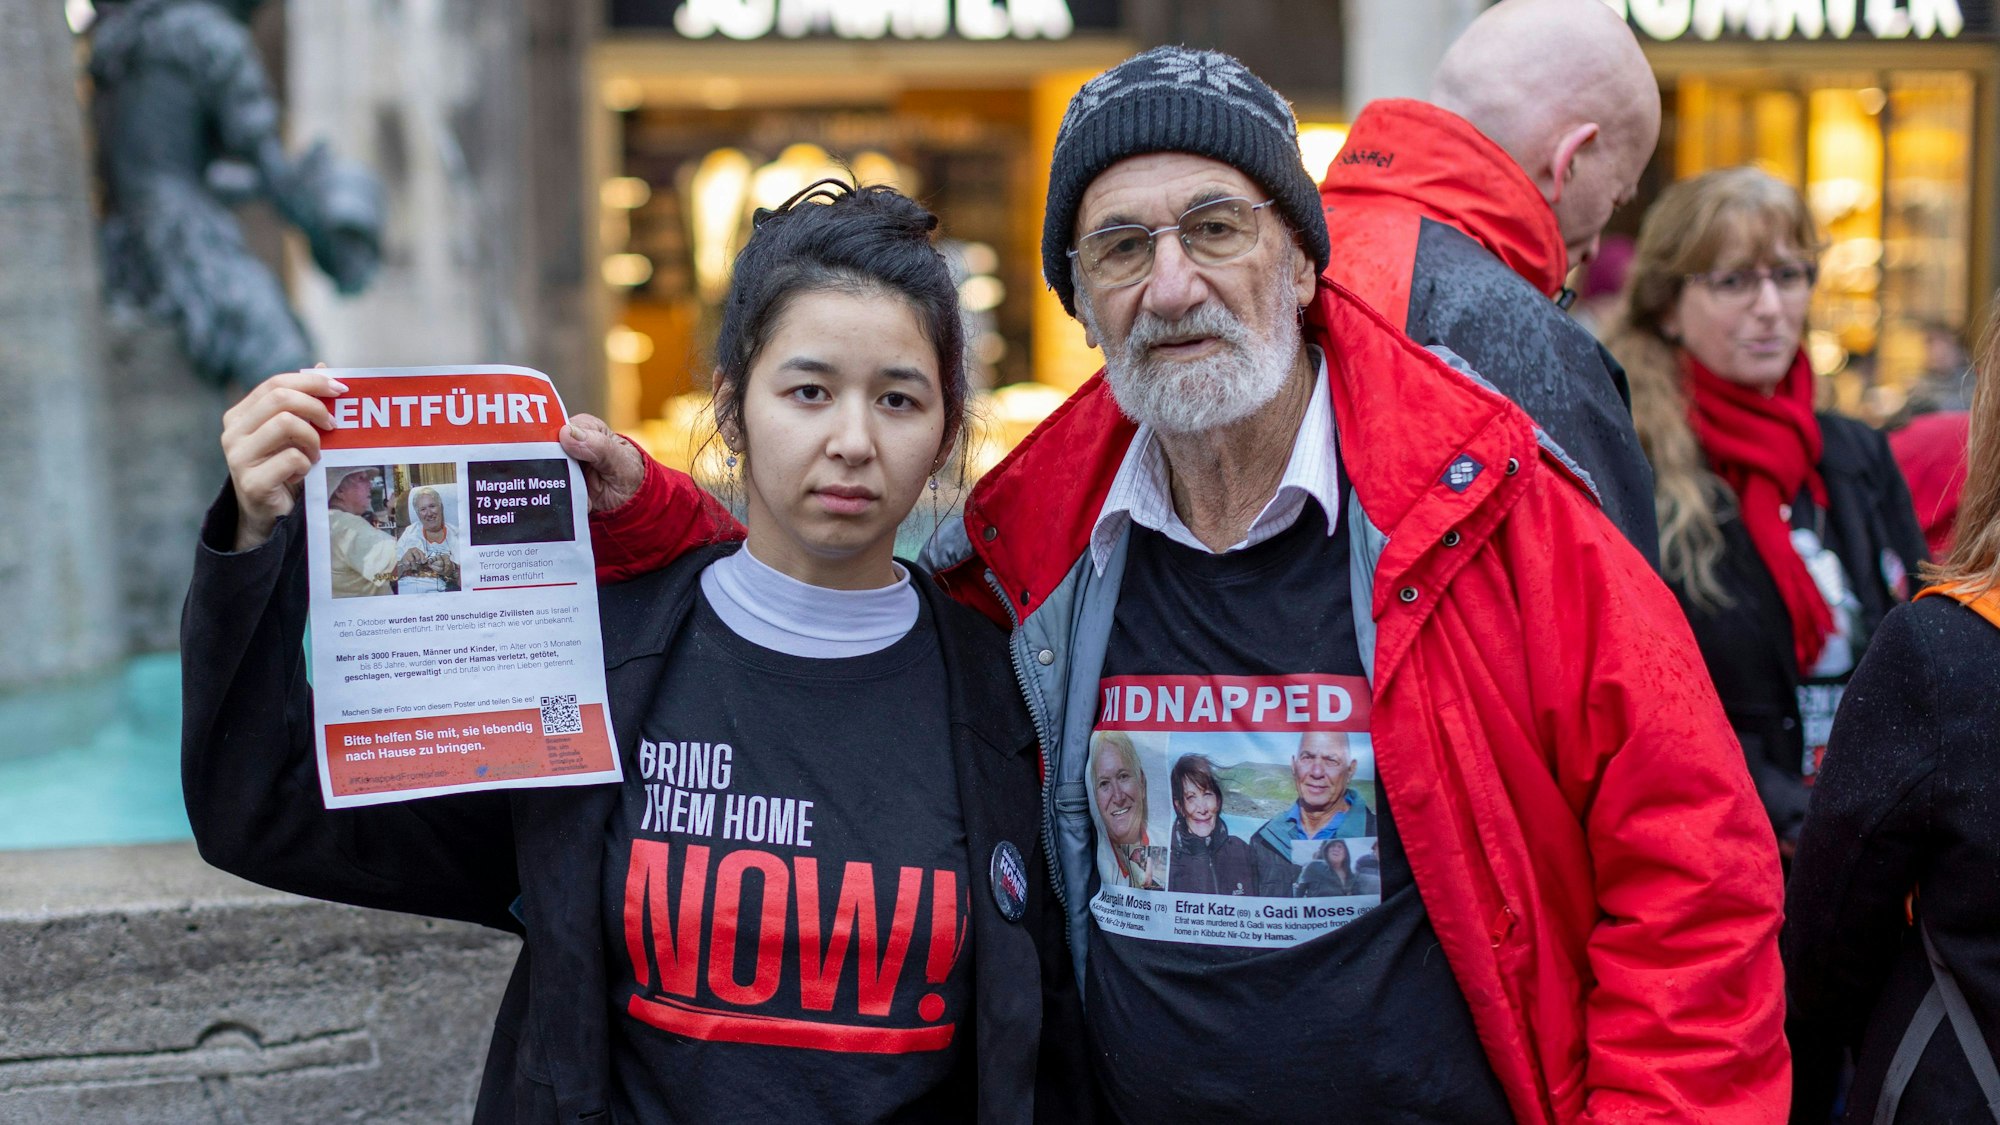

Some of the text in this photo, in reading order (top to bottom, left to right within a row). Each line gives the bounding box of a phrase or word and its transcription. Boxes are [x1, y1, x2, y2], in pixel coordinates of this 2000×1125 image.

[334, 388, 548, 429] ENTFÜHRT
[476, 477, 566, 494] Margalit Moses
[476, 493, 551, 511] 78 years old
[477, 512, 515, 525] Israeli
[479, 547, 538, 558] wurde von der
[479, 558, 554, 571] Terrororganisation
[480, 570, 545, 583] Hamas entführt
[333, 620, 346, 628] Am
[348, 619, 356, 627] 7.
[357, 618, 387, 627] Oktober
[388, 615, 417, 625] wurden
[419, 614, 434, 623] fast
[435, 613, 449, 621] 200
[451, 611, 498, 621] unschuldige
[500, 608, 534, 618] Zivilisten
[551, 606, 571, 614] Israel
[572, 605, 579, 613] in
[339, 630, 354, 638] den
[355, 627, 402, 637] Gazastreifen
[403, 625, 433, 634] entführt.
[447, 622, 476, 631] Verbleib
[477, 621, 486, 629] ist
[488, 620, 506, 628] nach
[507, 618, 520, 627] wie
[521, 618, 533, 626] vor
[534, 616, 575, 626] unbekannt.
[336, 654, 356, 662] Mehr
[357, 653, 369, 661] als
[371, 651, 390, 660] 3000
[391, 650, 421, 659] Frauen,
[423, 647, 451, 656] Männer
[453, 646, 468, 654] und
[470, 644, 498, 653] Kinder,
[550, 638, 582, 647] Monaten
[360, 663, 371, 671] bis
[373, 662, 382, 670] 85
[384, 660, 408, 669] Jahre,
[409, 658, 437, 667] wurden
[497, 652, 528, 661] verletzt,
[530, 650, 559, 659] getötet,
[344, 671, 392, 683] geschlagen,
[394, 668, 442, 679] vergewaltigt
[459, 665, 480, 674] brutal
[517, 660, 542, 669] Lieben
[543, 659, 575, 668] getrennt.
[342, 708, 370, 717] Machen
[396, 705, 412, 713] Foto
[427, 702, 453, 710] diesem
[454, 700, 476, 709] Poster
[492, 697, 510, 705] teilen
[511, 696, 523, 704] Sie
[524, 695, 535, 703] es!
[343, 721, 533, 747] Bitte helfen Sie mit, sie lebendig
[345, 742, 486, 762] nach Hause zu bringen.
[639, 738, 733, 790] BRING
[640, 784, 814, 847] THEM HOME
[1125, 895, 1152, 911] Moses
[1154, 903, 1168, 914] (78)
[1175, 900, 1204, 914] Efrat
[1208, 902, 1236, 917] Katz
[1236, 909, 1251, 919] (69)
[1254, 910, 1261, 918] &
[1263, 905, 1298, 919] Gadi
[1302, 905, 1355, 919] Moses
[1120, 920, 1127, 930] by
[1132, 912, 1145, 921] home
[1174, 916, 1190, 925] Efrat
[1191, 918, 1205, 926] was
[1206, 918, 1238, 928] murdered
[1239, 920, 1245, 928] &
[1246, 920, 1264, 929] Gadi
[1267, 922, 1282, 930] was
[1285, 921, 1328, 931] kidnapped
[1329, 920, 1348, 929] from
[624, 838, 962, 1022] NOW!
[1174, 927, 1297, 942] home in Kibbutz Nir-Oz by Hamas.
